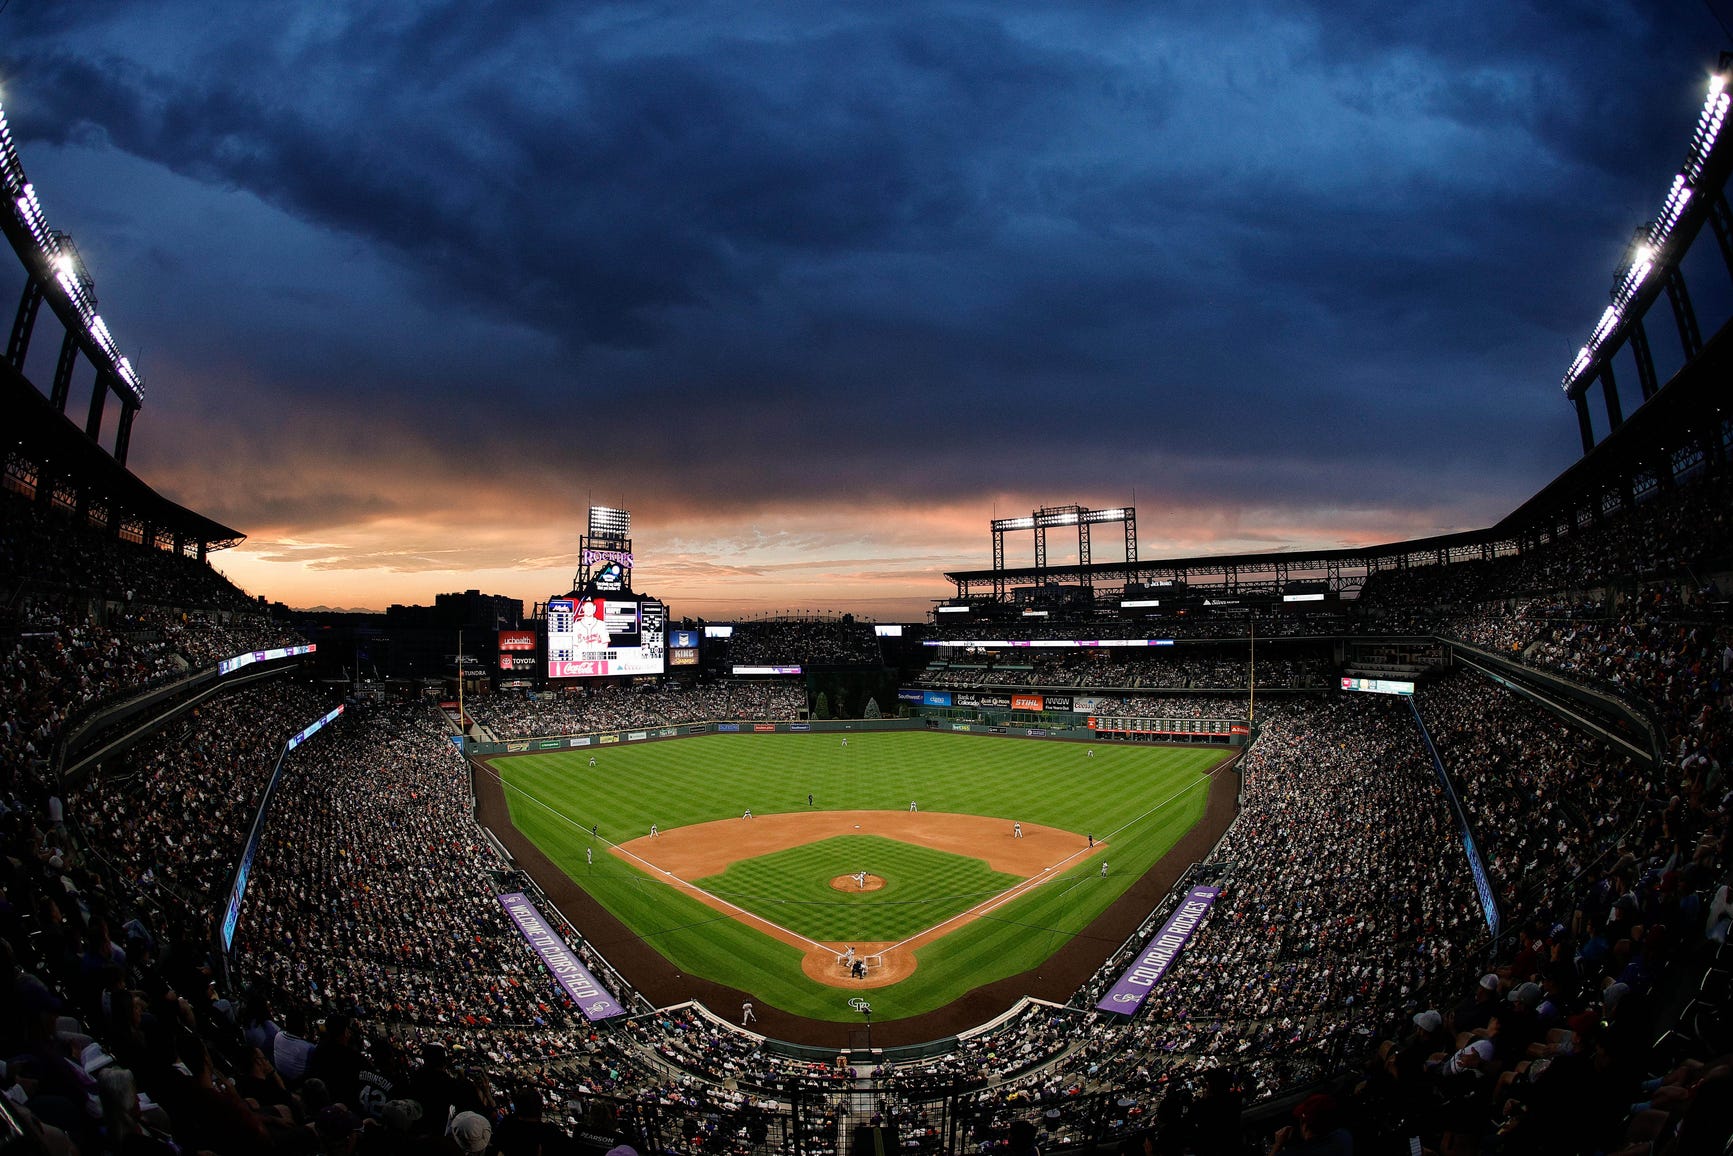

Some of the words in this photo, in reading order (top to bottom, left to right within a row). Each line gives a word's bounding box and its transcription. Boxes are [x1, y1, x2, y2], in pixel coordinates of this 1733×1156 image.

[582, 550, 634, 569] ROCKIES
[504, 636, 531, 645] uchealth
[675, 650, 694, 658] KING
[1016, 699, 1039, 707] STIHL
[508, 904, 547, 936] WELCOME
[533, 935, 556, 947] TO
[1127, 934, 1185, 987] COLORADO
[1167, 901, 1208, 935] ROCKIES
[540, 946, 578, 974] COORS
[561, 970, 599, 999] FIELD
[358, 1069, 393, 1092] ROBINSON
[359, 1084, 387, 1117] 42
